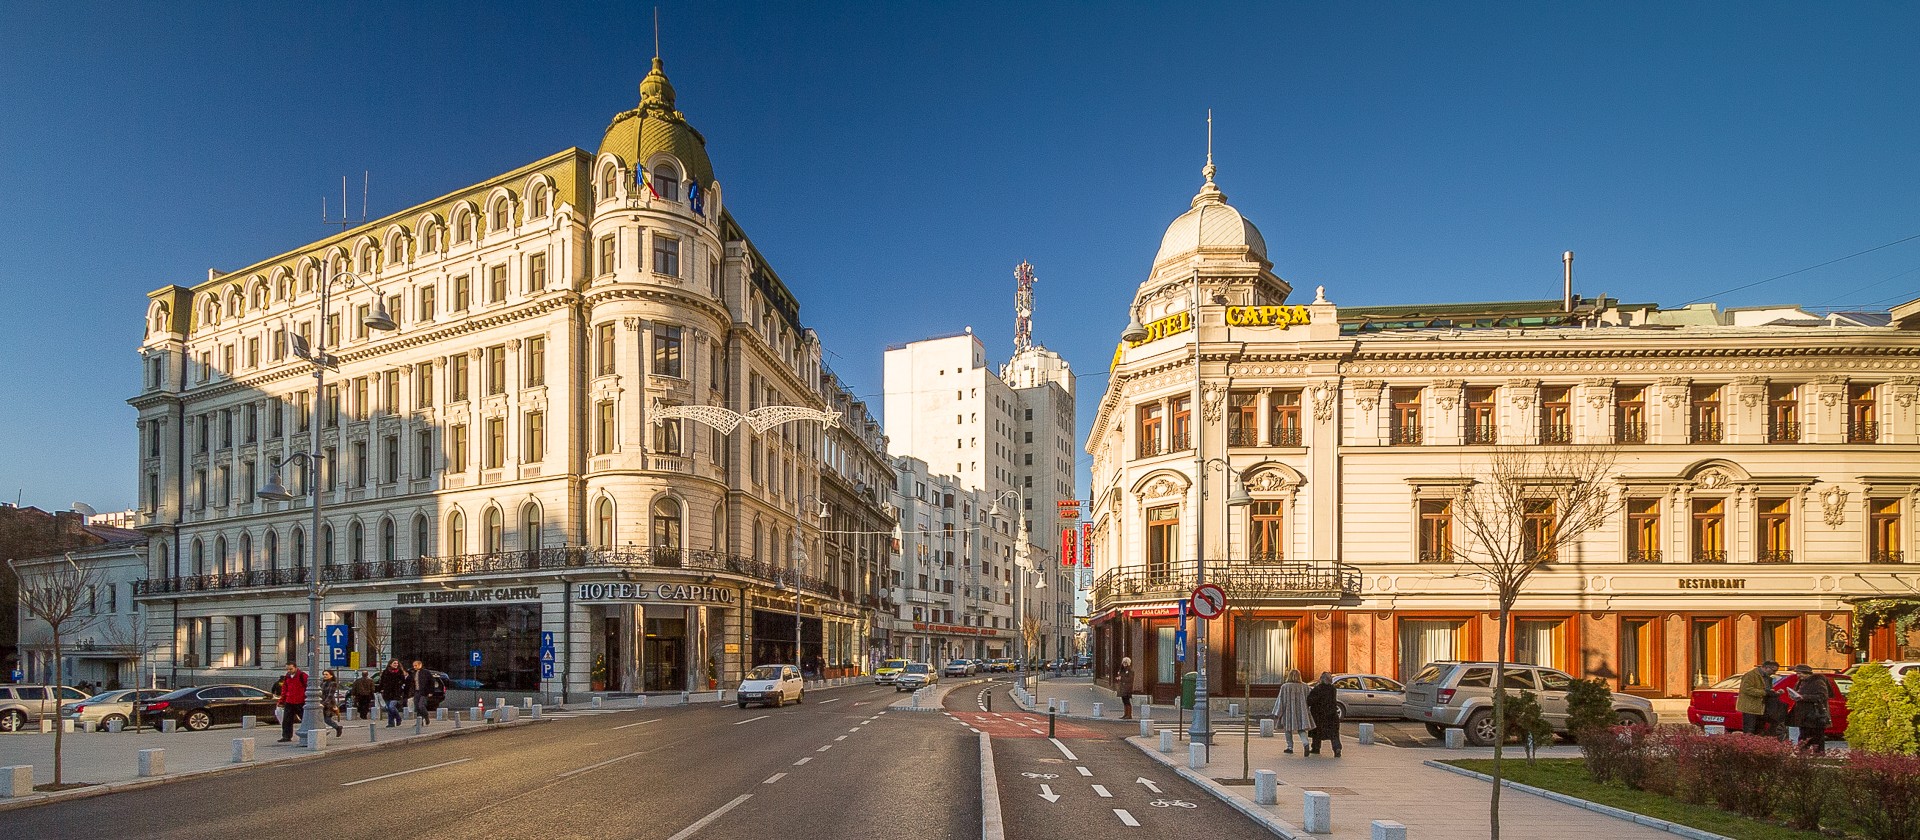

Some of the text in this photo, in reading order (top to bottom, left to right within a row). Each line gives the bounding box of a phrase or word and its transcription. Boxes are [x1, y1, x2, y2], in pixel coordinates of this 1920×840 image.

[1129, 311, 1190, 348] OTEL
[1678, 578, 1746, 589] RESTAURANT
[397, 587, 540, 605] HOTEL RESTAURANT CAPITOL
[578, 583, 735, 604] HOTEL CAPITOL
[333, 648, 343, 660] P
[472, 652, 480, 662] P
[544, 664, 552, 674] P
